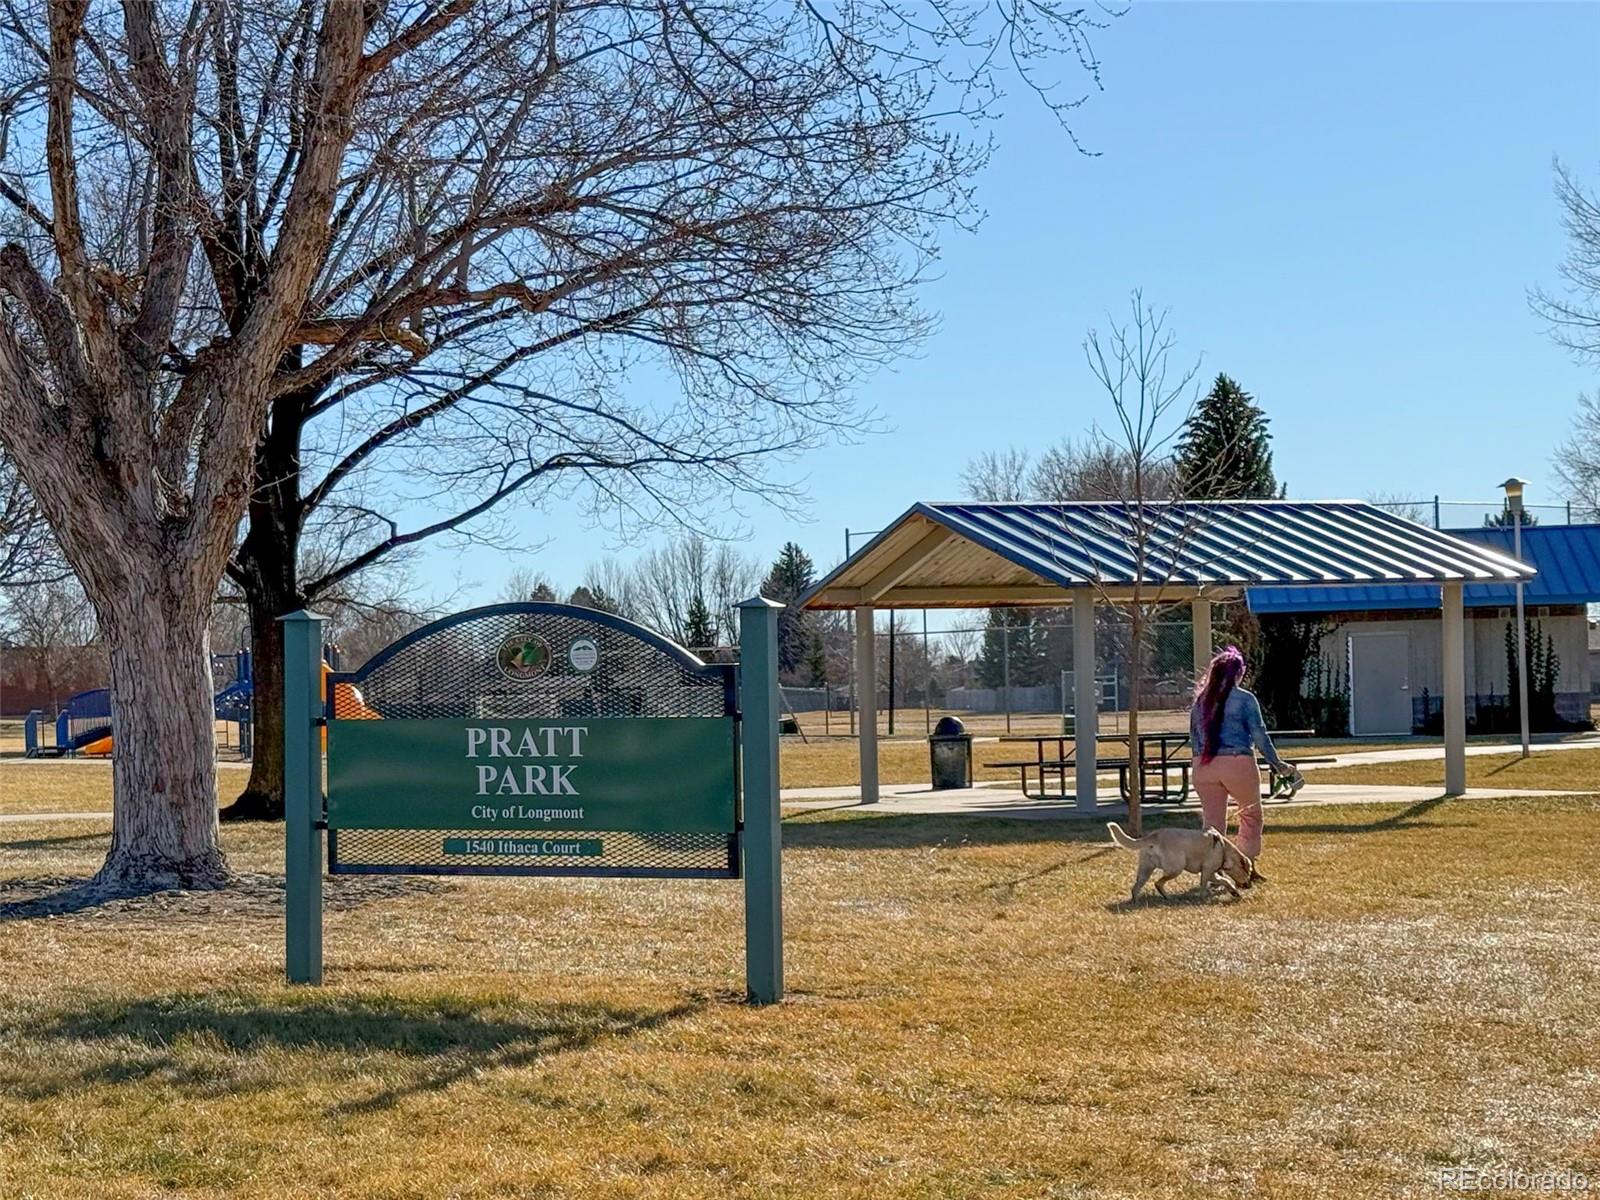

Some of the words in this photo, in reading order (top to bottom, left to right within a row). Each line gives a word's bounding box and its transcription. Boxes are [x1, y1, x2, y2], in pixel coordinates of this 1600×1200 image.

[503, 664, 546, 679] LONGMONT
[465, 727, 588, 757] PRATT
[475, 765, 580, 795] PARK
[471, 805, 498, 821] City
[502, 805, 516, 819] of
[518, 805, 584, 822] Longmont
[465, 840, 494, 853] 1540
[498, 840, 538, 854] Ithaca
[542, 840, 580, 854] Court
